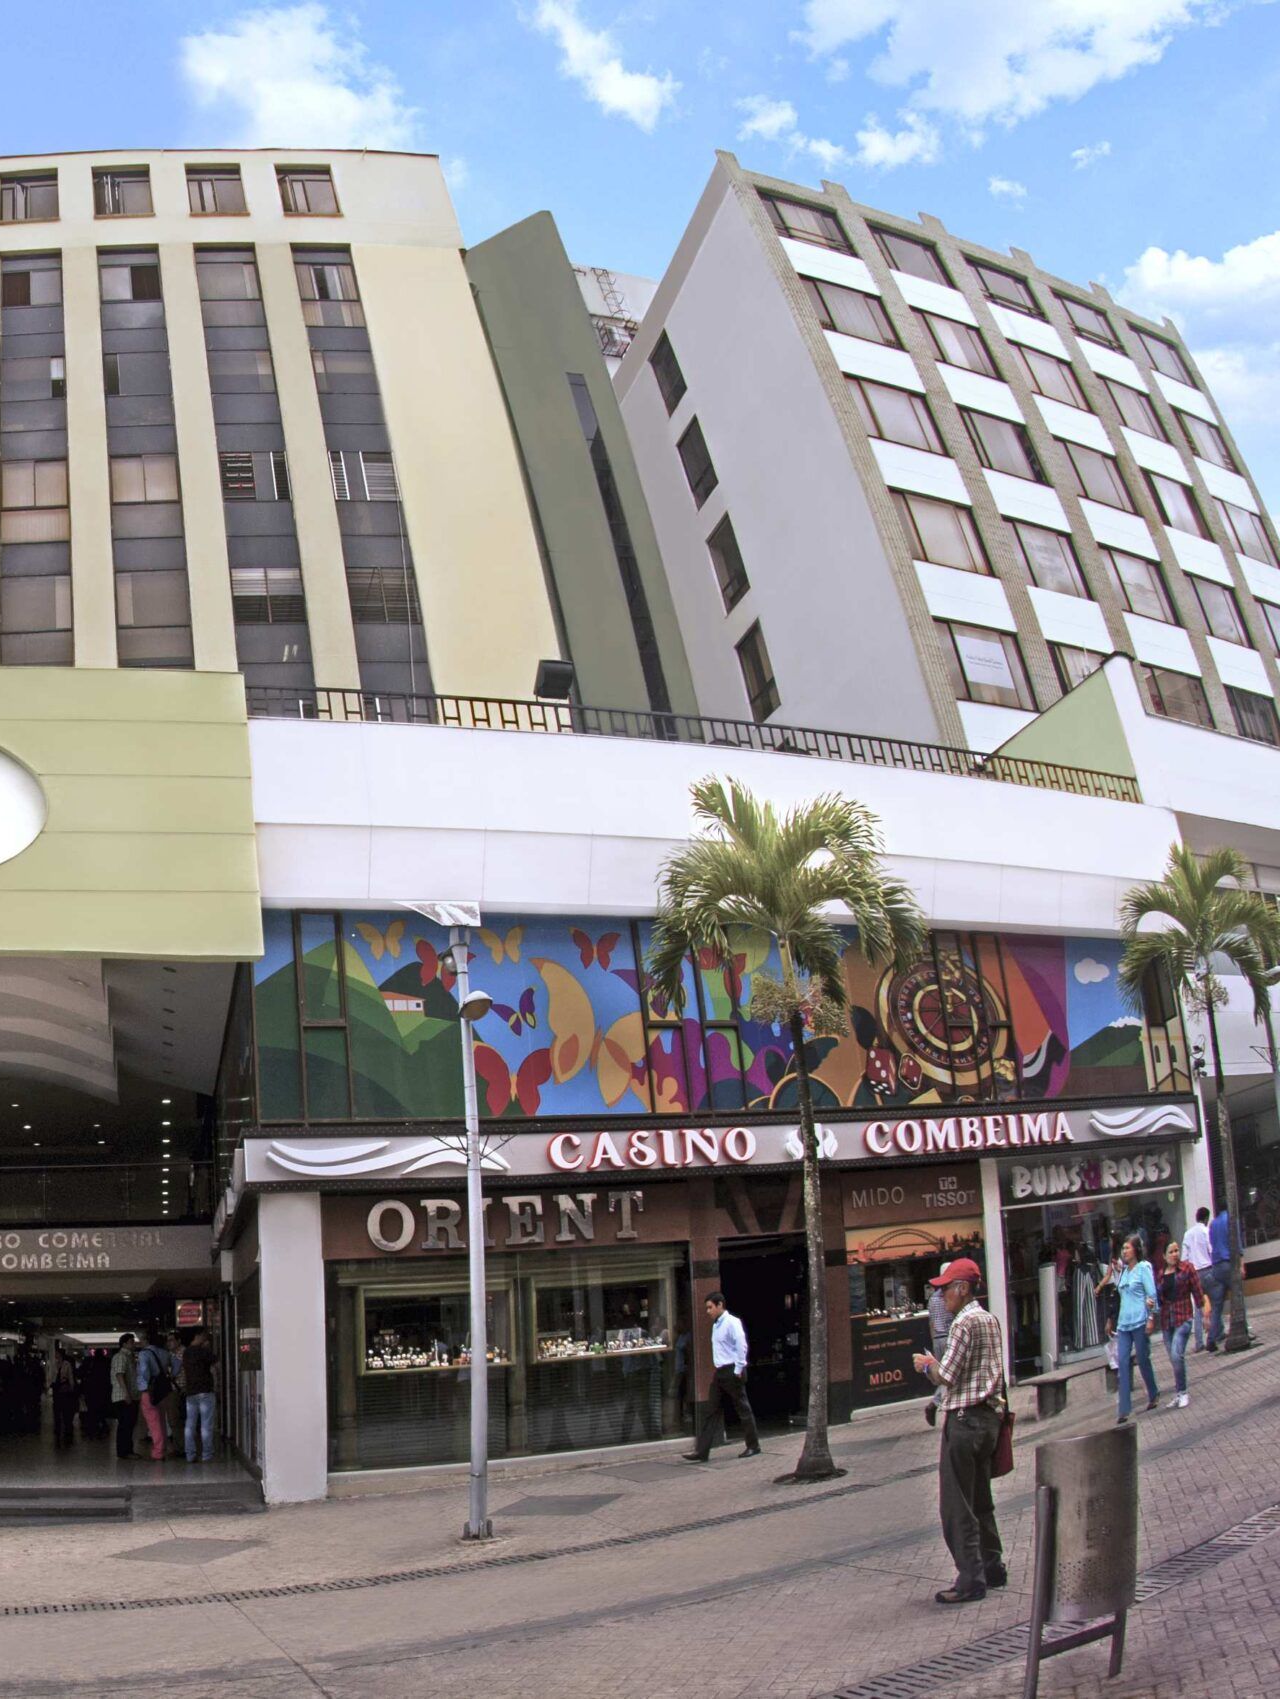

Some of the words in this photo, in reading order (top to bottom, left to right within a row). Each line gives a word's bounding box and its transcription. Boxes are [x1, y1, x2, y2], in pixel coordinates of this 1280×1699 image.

[546, 1126, 757, 1172] CASINO
[864, 1111, 1075, 1156] COMBEIMA
[851, 1186, 905, 1209] MIDO
[922, 1190, 976, 1208] TISSOT
[1011, 1163, 1082, 1199] BUMS
[1101, 1151, 1171, 1189] ROSES
[366, 1190, 644, 1252] ORIENT
[869, 1369, 903, 1385] MIDO
